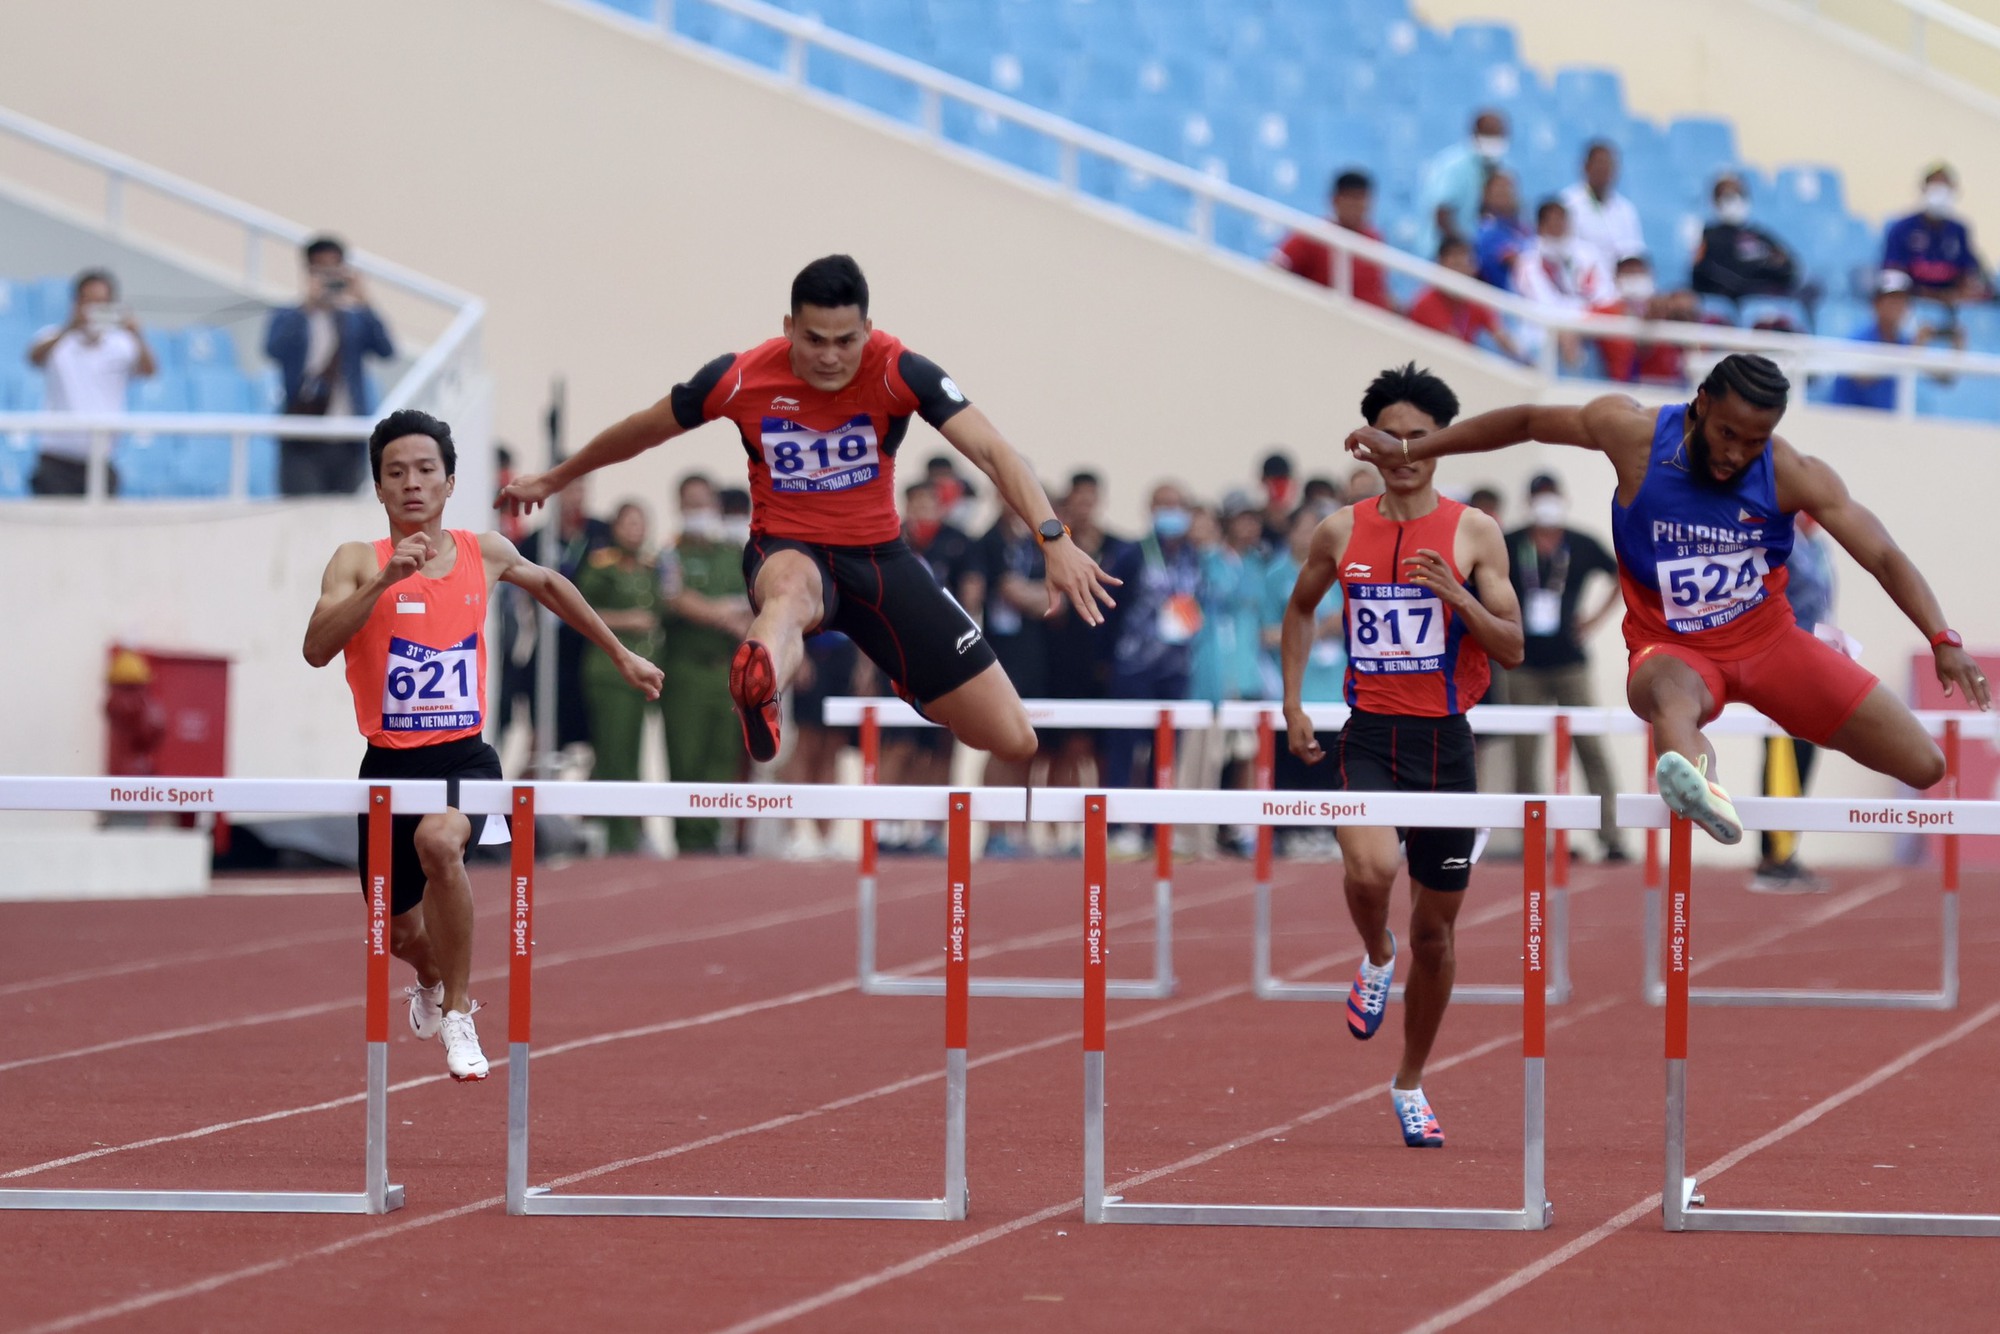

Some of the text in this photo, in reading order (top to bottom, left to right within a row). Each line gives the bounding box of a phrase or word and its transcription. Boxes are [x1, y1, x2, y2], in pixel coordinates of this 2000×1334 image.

[773, 434, 868, 474] 818
[781, 480, 808, 491] HANOI
[816, 475, 852, 490] VIETNAM
[852, 467, 873, 484] 2022
[1697, 544, 1716, 554] SEA
[1718, 543, 1748, 553] Game
[1376, 586, 1393, 598] SEA
[1394, 586, 1422, 598] Games
[1669, 557, 1759, 607] 524
[1357, 607, 1433, 645] 817
[1676, 620, 1705, 632] HANOI
[1711, 602, 1744, 627] VIETNAM
[388, 658, 469, 701] 621
[1383, 660, 1420, 672] VIETNAM
[1420, 658, 1440, 671] 2022
[388, 716, 413, 729] HANOI
[420, 714, 457, 728] VIETNAM
[458, 714, 475, 726] 2022
[411, 704, 454, 712] SINGAPORE
[167, 788, 215, 806] Sport
[746, 794, 794, 812] Sport
[1320, 802, 1367, 820] Sport
[1907, 810, 1954, 828] Sport
[371, 920, 385, 956] Sport
[513, 920, 527, 956] Sport
[950, 926, 964, 962] Sport
[1087, 929, 1101, 965] Sport
[1527, 935, 1541, 972] Sport
[1671, 936, 1685, 973] Sport
